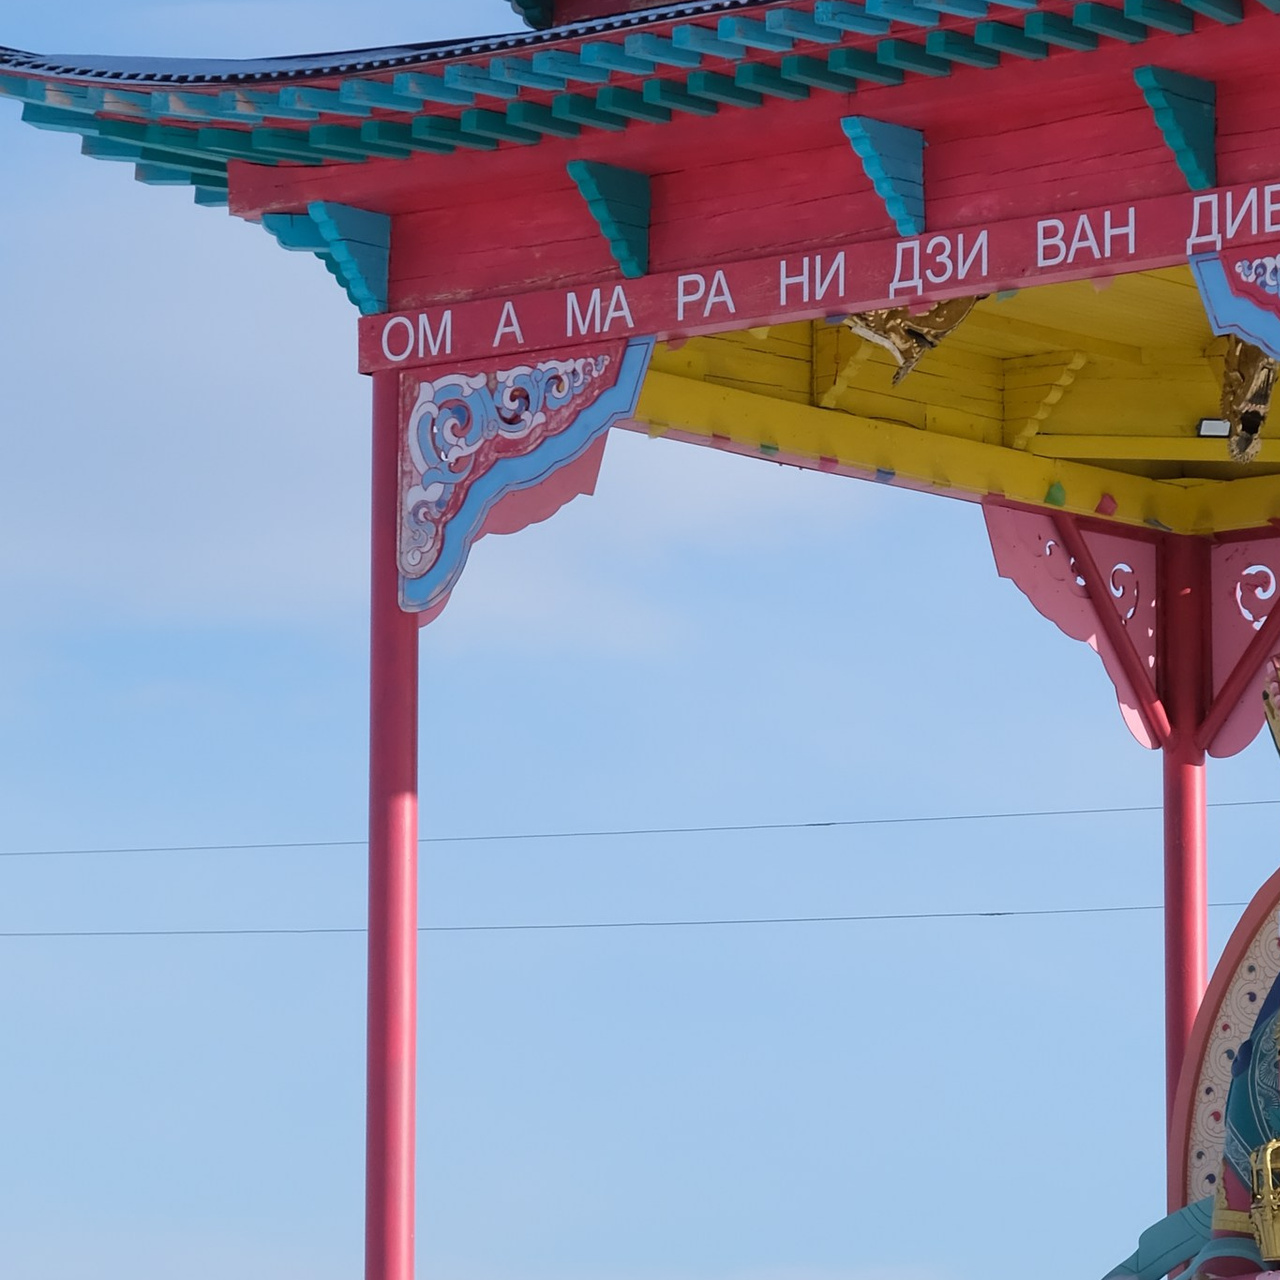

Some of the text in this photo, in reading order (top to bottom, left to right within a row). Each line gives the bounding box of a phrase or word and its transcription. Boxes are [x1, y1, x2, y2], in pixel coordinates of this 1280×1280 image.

[381, 309, 452, 362] ОМ
[493, 300, 525, 348] А
[566, 285, 634, 337] МА
[677, 269, 736, 322] РА
[779, 251, 846, 307] НИ
[889, 229, 989, 300] ДЗИ
[1036, 206, 1136, 268] ВАН
